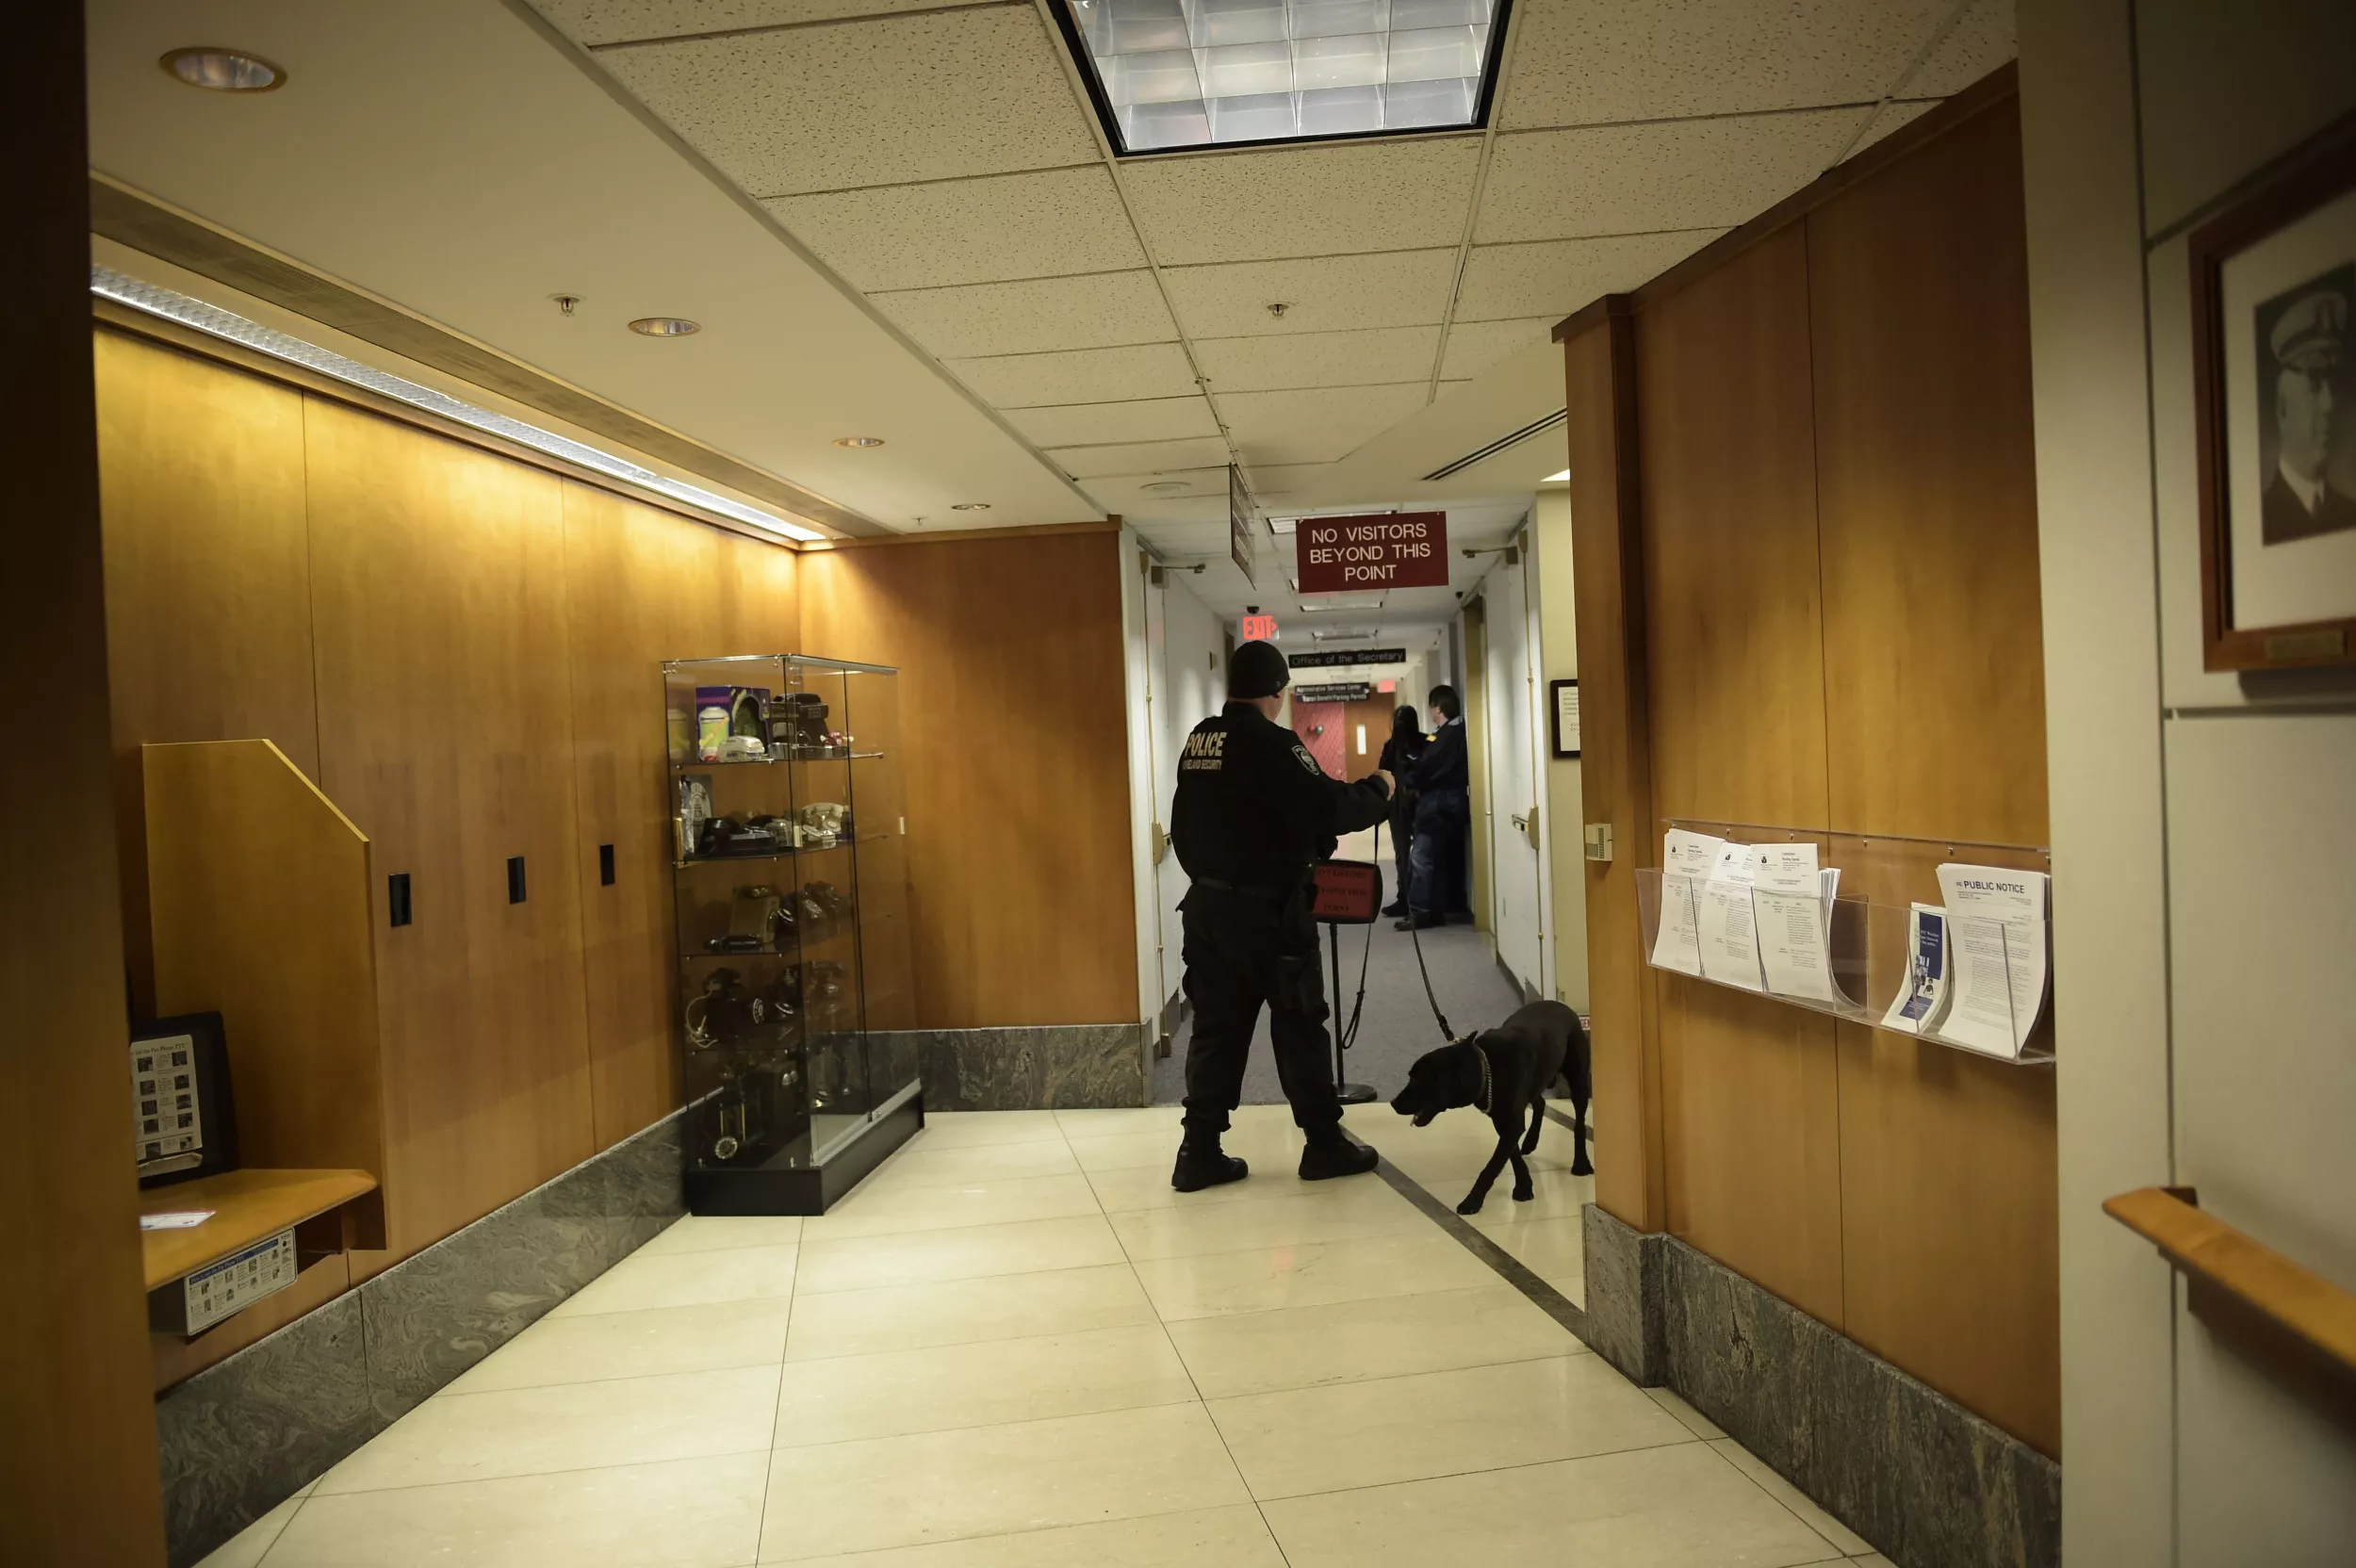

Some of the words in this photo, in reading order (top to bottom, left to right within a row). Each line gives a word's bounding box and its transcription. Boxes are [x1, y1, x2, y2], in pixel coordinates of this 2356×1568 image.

[1311, 528, 1338, 544] NO
[1346, 523, 1428, 542] VISITORS
[1309, 545, 1384, 564] BEYOND
[1392, 543, 1432, 560] THIS
[1345, 564, 1398, 581] POINT
[1243, 615, 1273, 641] EXIT
[1292, 656, 1321, 665] Office
[1326, 655, 1334, 663] of
[1338, 655, 1353, 663] the
[1357, 651, 1403, 662] Secretary
[1184, 731, 1228, 758] POLICE
[1963, 880, 1995, 890] PUBLIC
[1996, 883, 2025, 894] NOTICE
